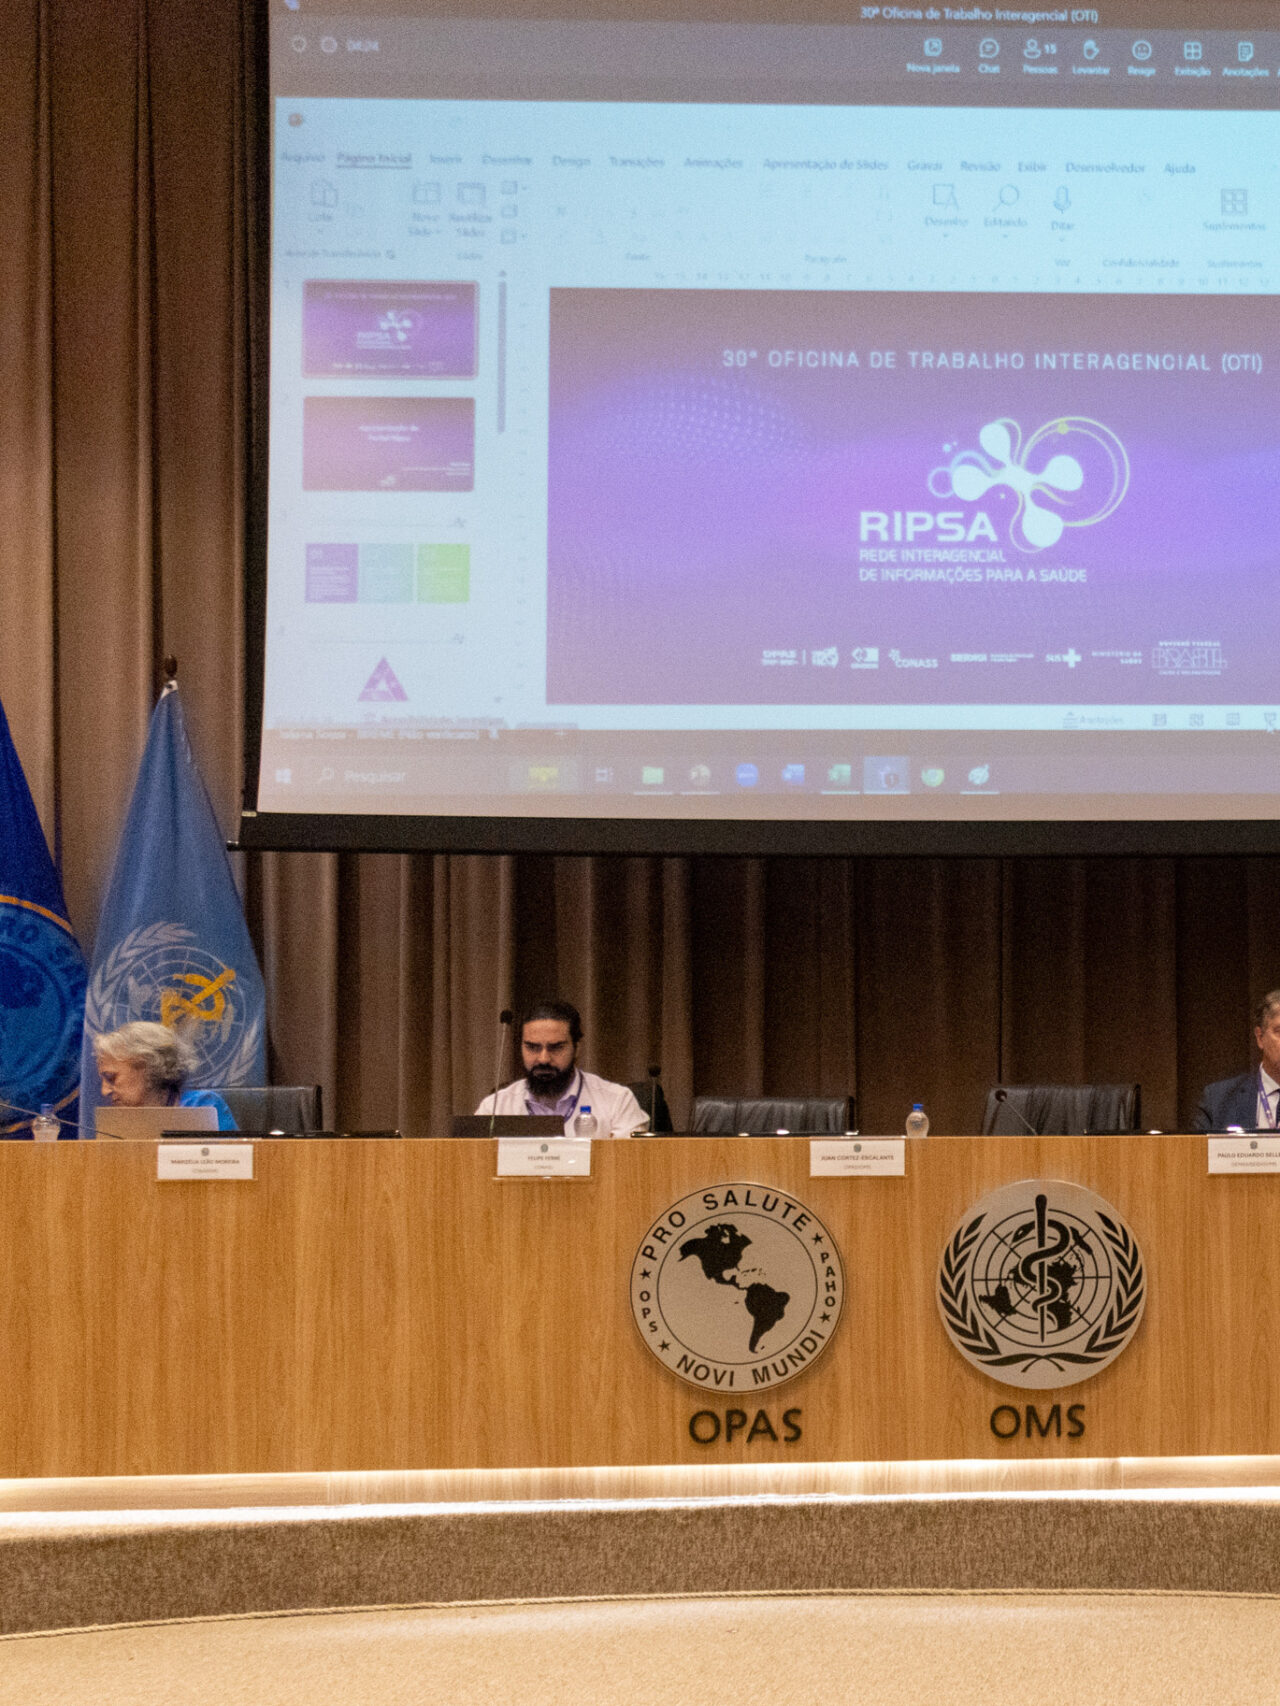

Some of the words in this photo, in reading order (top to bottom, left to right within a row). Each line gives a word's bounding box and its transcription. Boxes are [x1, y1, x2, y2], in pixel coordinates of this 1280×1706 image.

[882, 7, 923, 20] Oficina
[926, 7, 941, 20] de
[944, 8, 993, 21] Trabalho
[996, 9, 1068, 24] Interagencial
[1071, 10, 1099, 23] (OTI)
[906, 63, 929, 74] Nova
[978, 63, 1000, 75] Chat
[769, 350, 860, 368] OFICINA
[869, 351, 897, 369] DE
[907, 351, 1025, 370] TRABALHO
[1034, 352, 1211, 372] INTERAGENCIAL
[1221, 353, 1263, 374] (OTI)
[859, 510, 998, 543] RIPSA
[859, 548, 898, 563] REDE
[901, 548, 1006, 563] INTERAGENCIAL
[859, 567, 879, 582] DE
[881, 567, 983, 585] INFORMAÇÕES
[986, 567, 1024, 583] PARA
[1026, 568, 1038, 583] A
[1040, 566, 1088, 584] SAÚDE
[895, 658, 939, 669] CONASS
[641, 1210, 686, 1261] PRO
[702, 1189, 812, 1232] SALUTE
[820, 1252, 837, 1308] PAHO
[639, 1290, 658, 1333] OPS
[676, 1354, 735, 1387] NOVI
[751, 1329, 825, 1385] MUNDI
[688, 1408, 803, 1444] OPAS
[989, 1404, 1085, 1439] OMS
